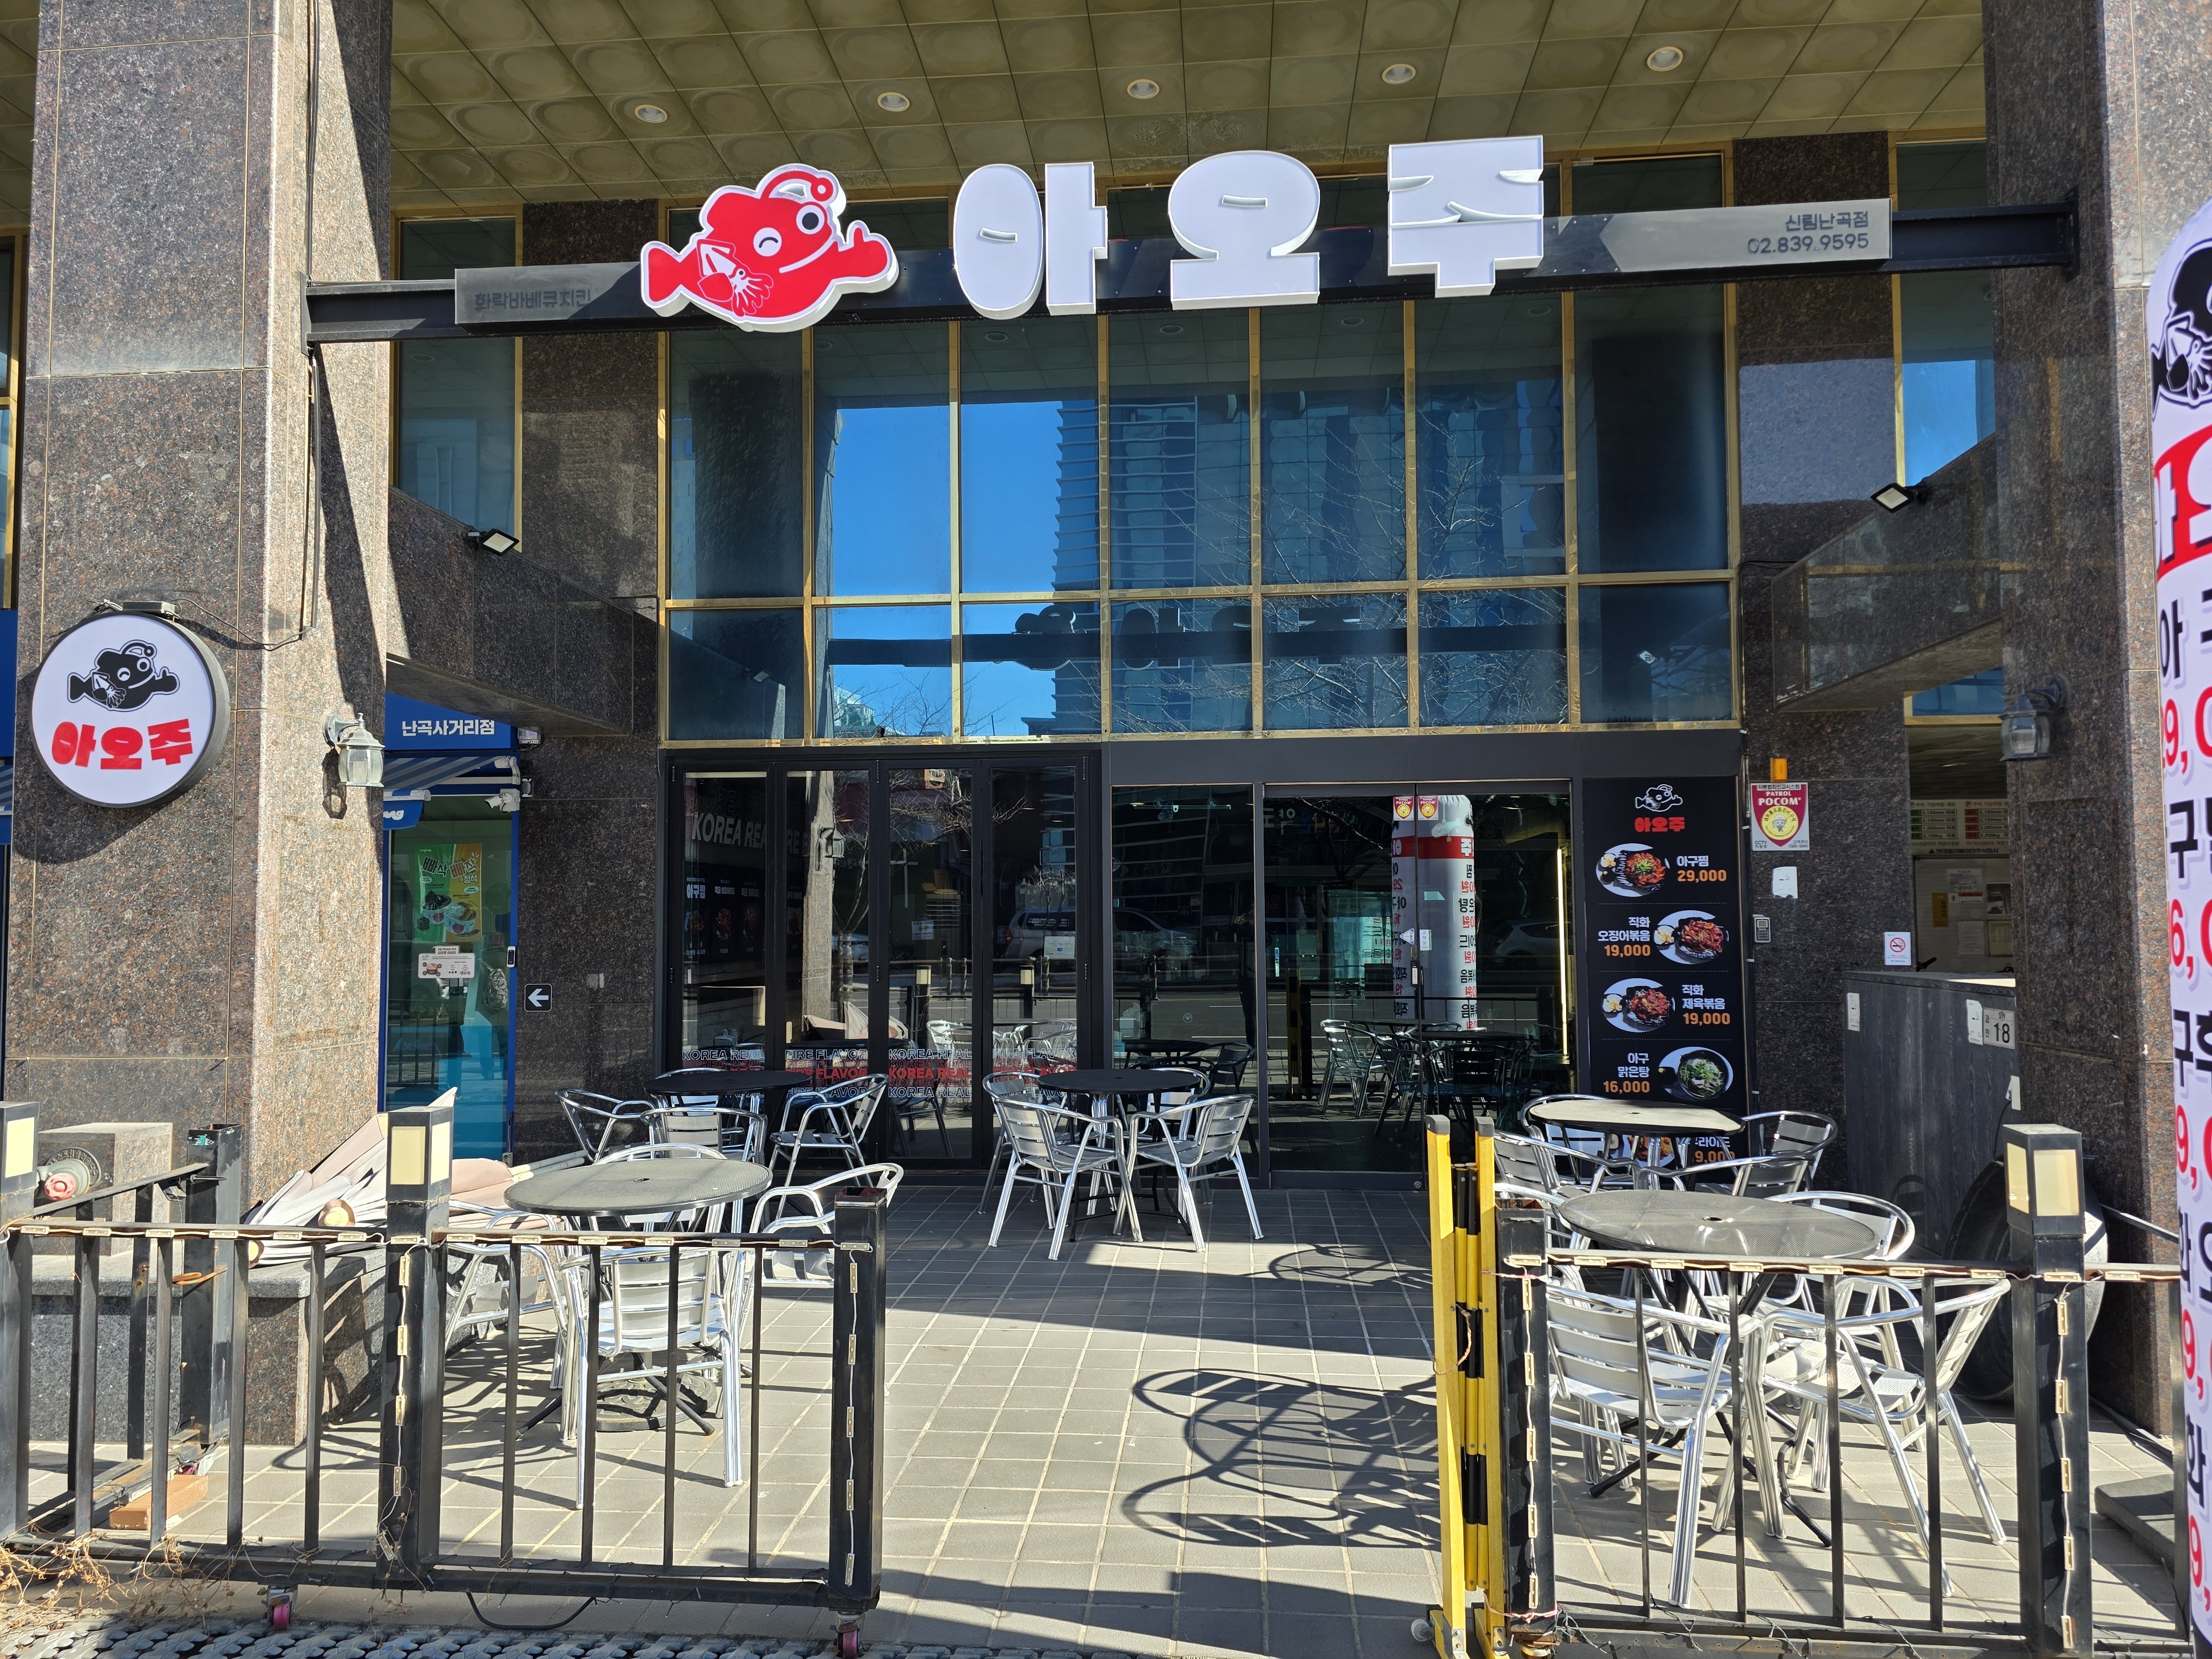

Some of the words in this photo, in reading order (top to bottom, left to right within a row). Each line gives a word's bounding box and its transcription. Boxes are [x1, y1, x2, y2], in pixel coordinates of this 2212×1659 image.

[953, 135, 1543, 320] 아오주
[1785, 211, 1868, 232] 신림난곡점
[1747, 233, 1869, 254] 02.839.9595
[402, 719, 495, 737] 난곡사거리점
[51, 718, 193, 770] 아오주
[692, 812, 741, 846] KOREA
[744, 821, 766, 849] REA
[1635, 817, 1685, 832] 아오주
[1676, 855, 1709, 867] 아구찜
[1677, 869, 1726, 883] 29,000
[1628, 916, 1650, 928] 직화
[1598, 930, 1651, 942] 오징어볶음
[1604, 944, 1651, 958] 19,000
[1682, 984, 1704, 996] 직화
[1682, 998, 1725, 1010] 제육볶음
[1683, 1013, 1730, 1026] 19,000
[1994, 1022, 2010, 1044] 18
[682, 1050, 727, 1060] KOREA
[731, 1050, 765, 1060] REAL
[785, 1049, 813, 1060] FIRE
[889, 1048, 935, 1060] KOREA
[937, 1048, 972, 1060] REAL
[1627, 1052, 1650, 1064] 아구
[888, 1067, 935, 1079] KOREA
[937, 1067, 972, 1079] REAL
[1618, 1066, 1650, 1078] 맑은탕
[888, 1087, 935, 1098] KOREA
[937, 1087, 972, 1098] REAL
[1603, 1081, 1650, 1094] 16,000
